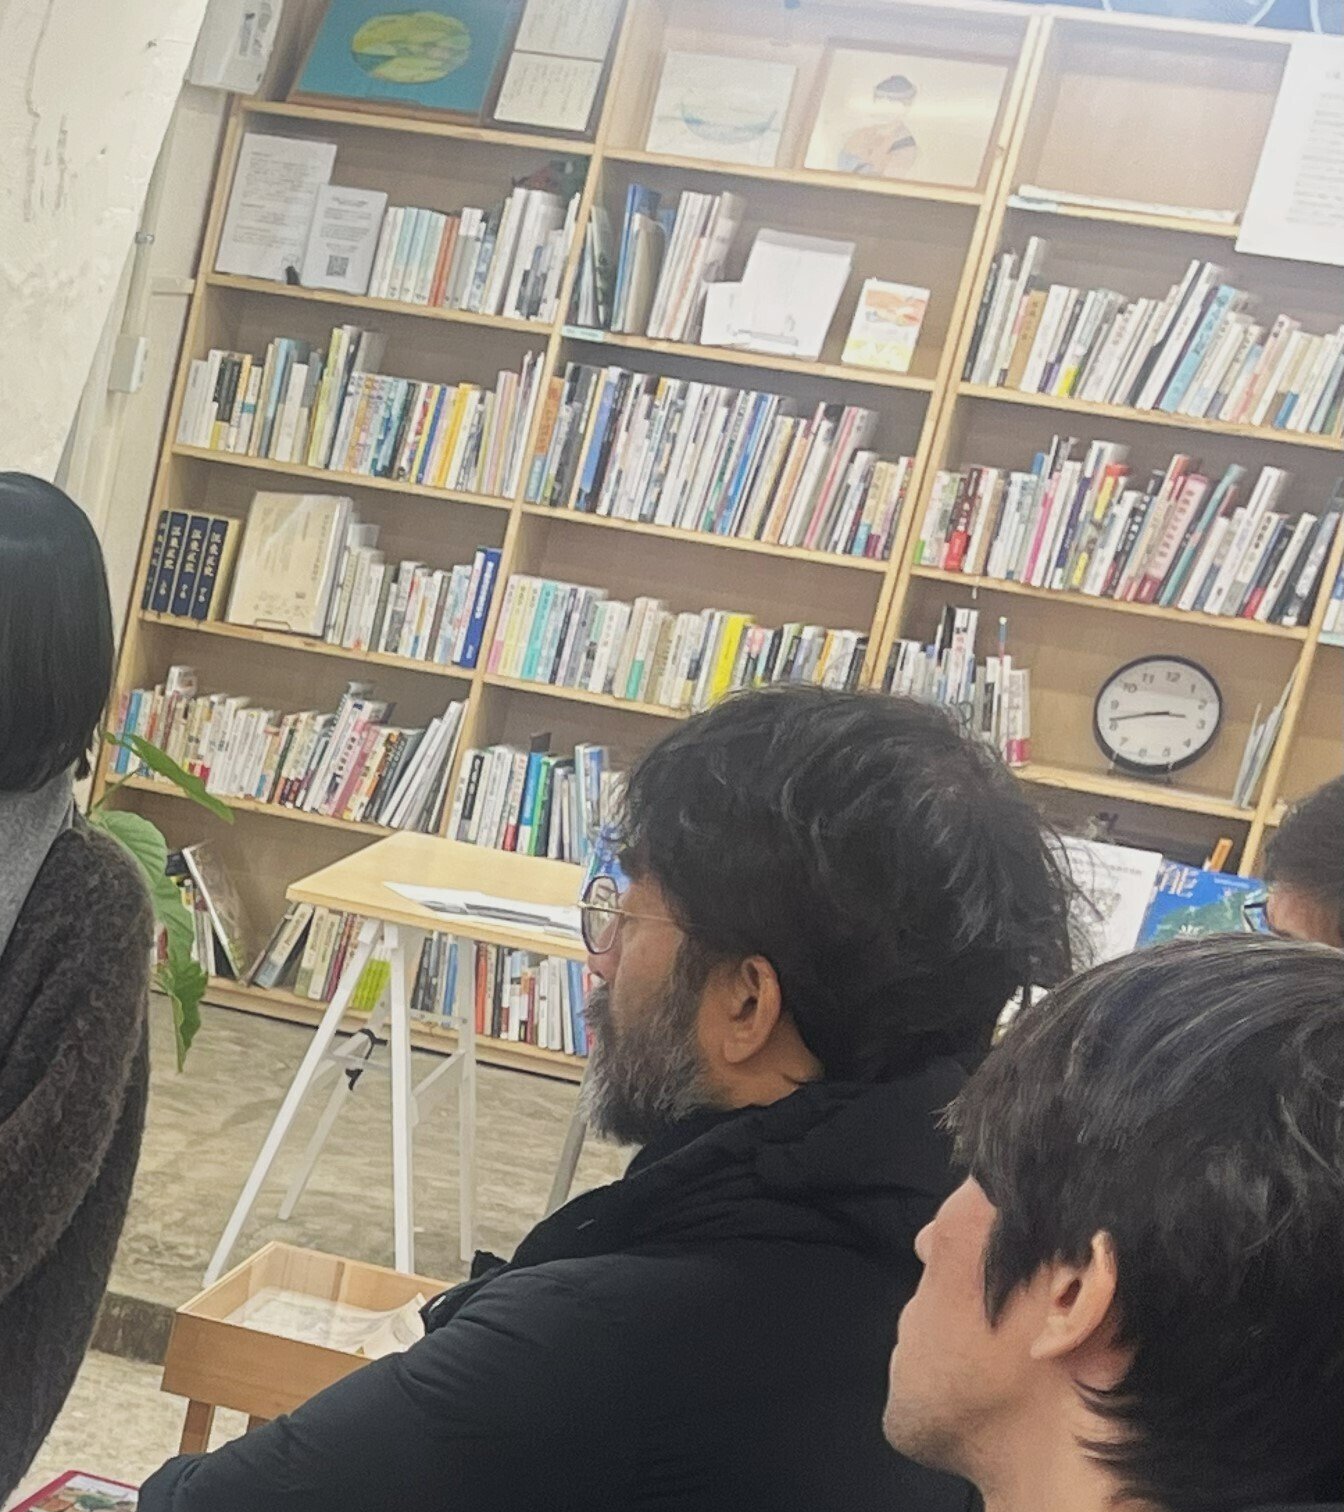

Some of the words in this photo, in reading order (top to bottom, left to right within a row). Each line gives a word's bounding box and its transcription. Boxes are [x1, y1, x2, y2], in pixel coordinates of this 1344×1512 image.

[1143, 673, 1155, 683] 11
[1166, 672, 1180, 682] 12
[1123, 682, 1138, 693] 10
[1190, 684, 1196, 693] 1
[1197, 700, 1208, 711] 2
[1196, 718, 1206, 730] 3
[1119, 736, 1129, 747] 7
[1183, 738, 1191, 748] 4
